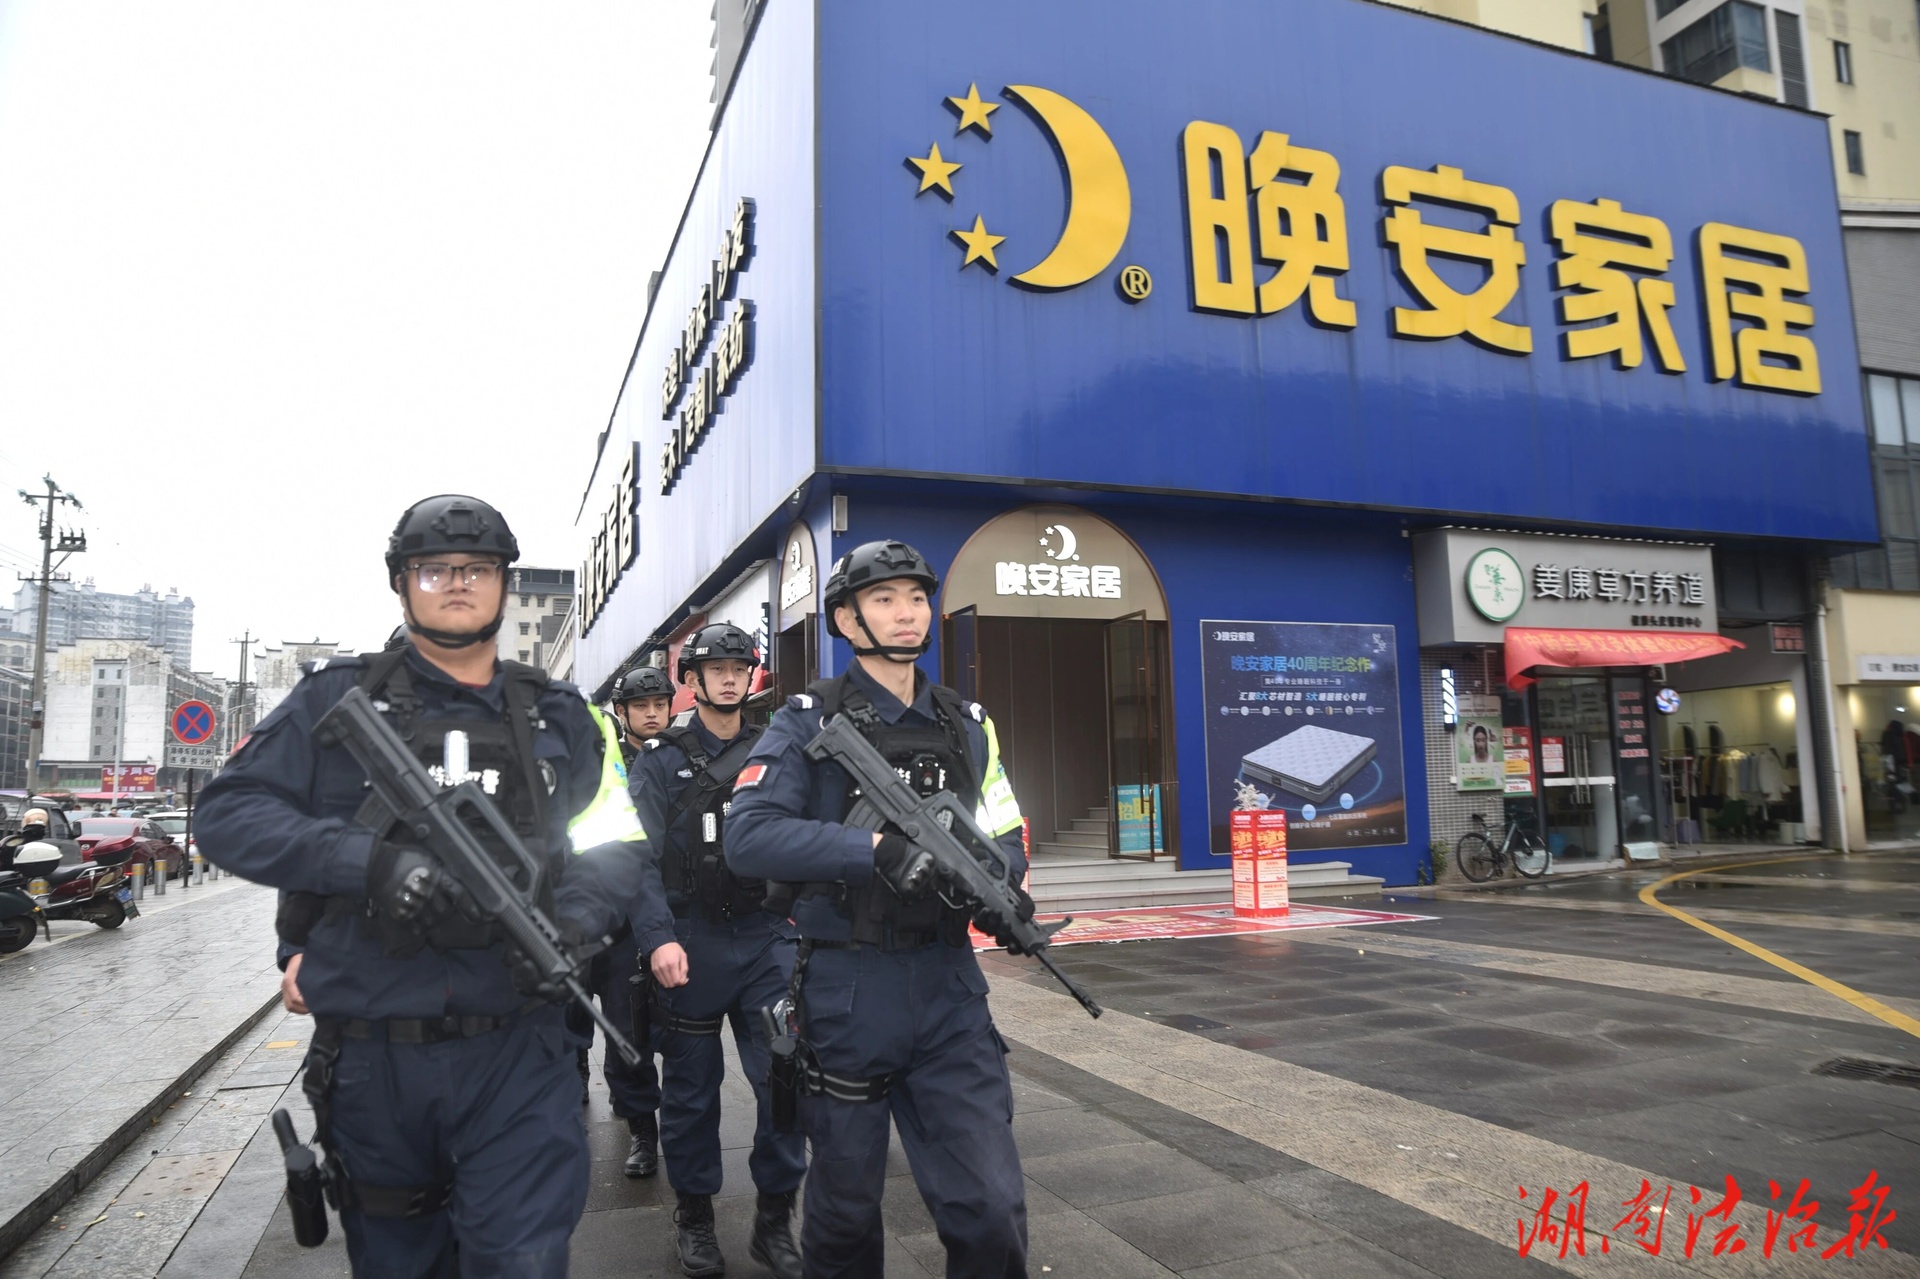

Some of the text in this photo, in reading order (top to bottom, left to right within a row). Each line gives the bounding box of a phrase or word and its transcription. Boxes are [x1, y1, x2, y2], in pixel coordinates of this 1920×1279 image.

[1181, 119, 1823, 397] 晚安家居
[994, 561, 1122, 599] 晚安家居
[1533, 562, 1706, 606] 姜康草方养道
[1230, 654, 1372, 673] 晚安家居40周年纪念作
